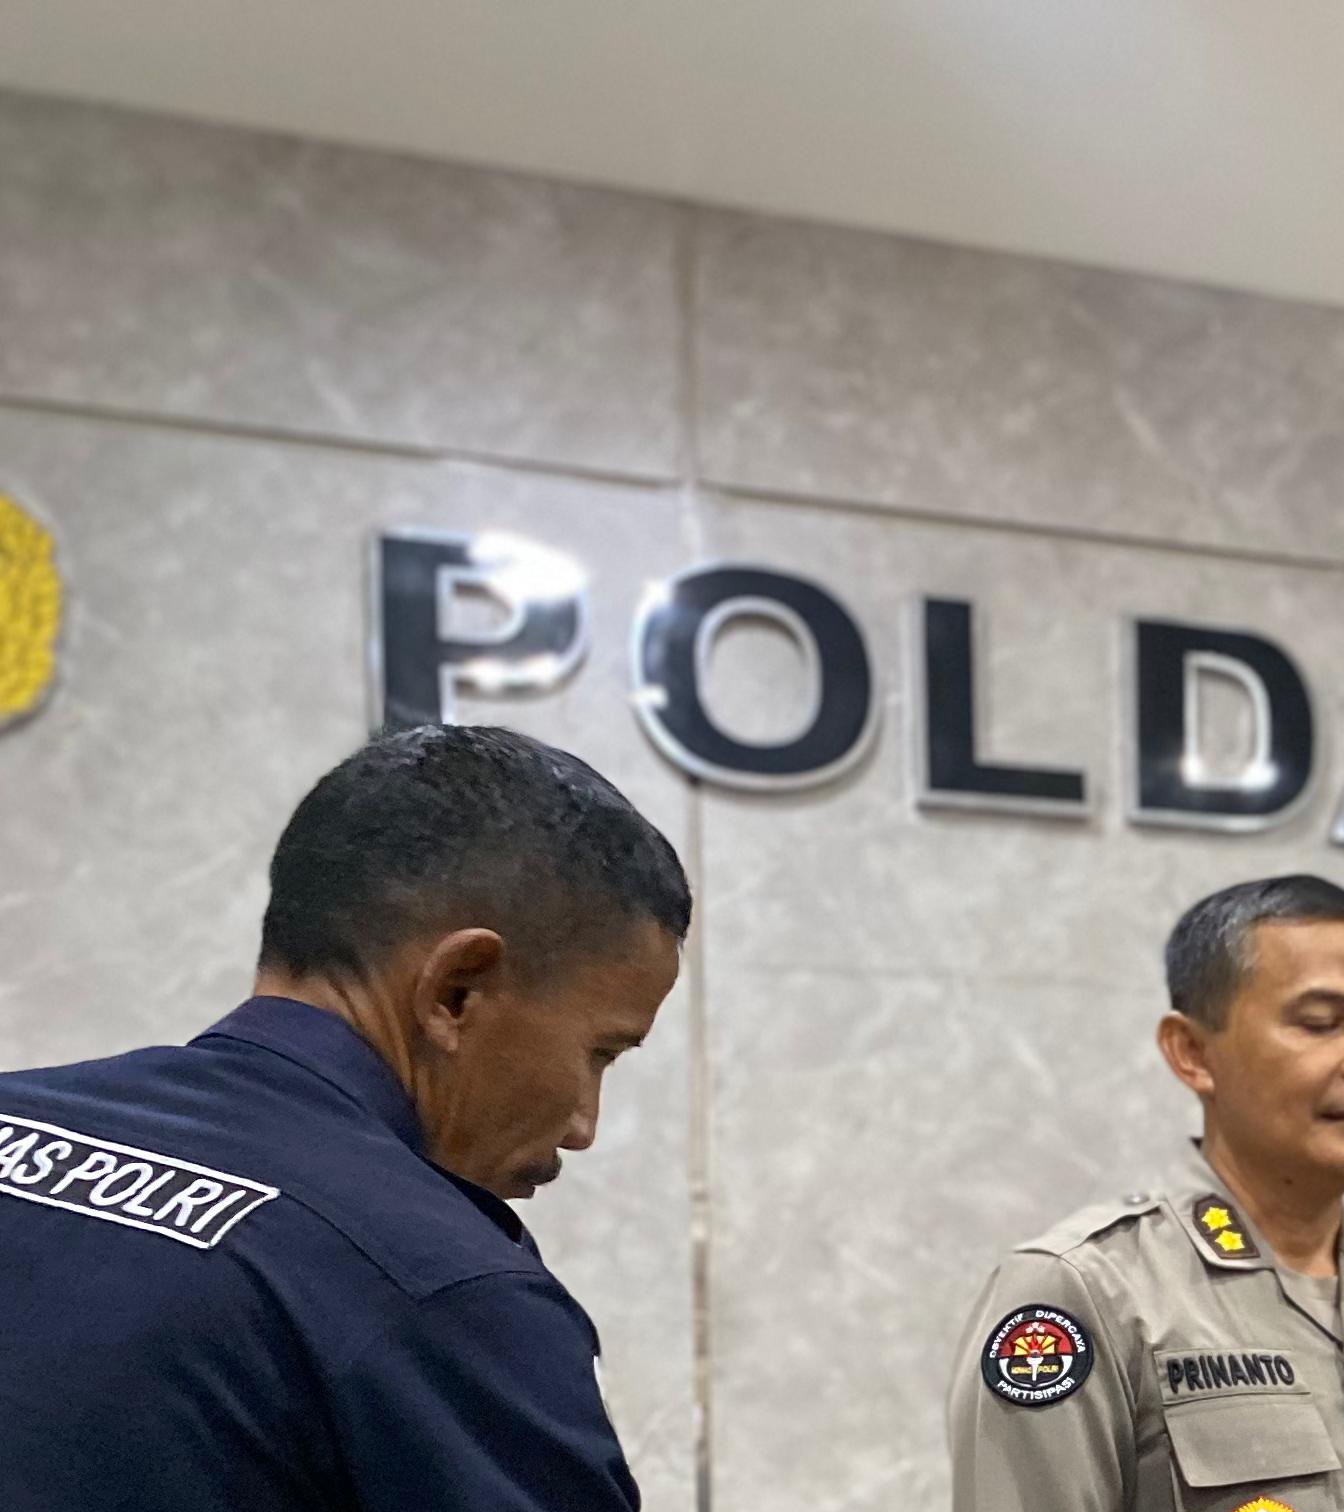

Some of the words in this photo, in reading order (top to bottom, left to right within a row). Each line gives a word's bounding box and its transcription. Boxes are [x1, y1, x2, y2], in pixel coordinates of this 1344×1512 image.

[0, 1126, 72, 1185] AS
[49, 1151, 247, 1233] POLRI
[1035, 1310, 1086, 1353] DIPERCAYA
[997, 1376, 1076, 1400] PARTISIPASI
[1167, 1354, 1295, 1394] PRINANTO
